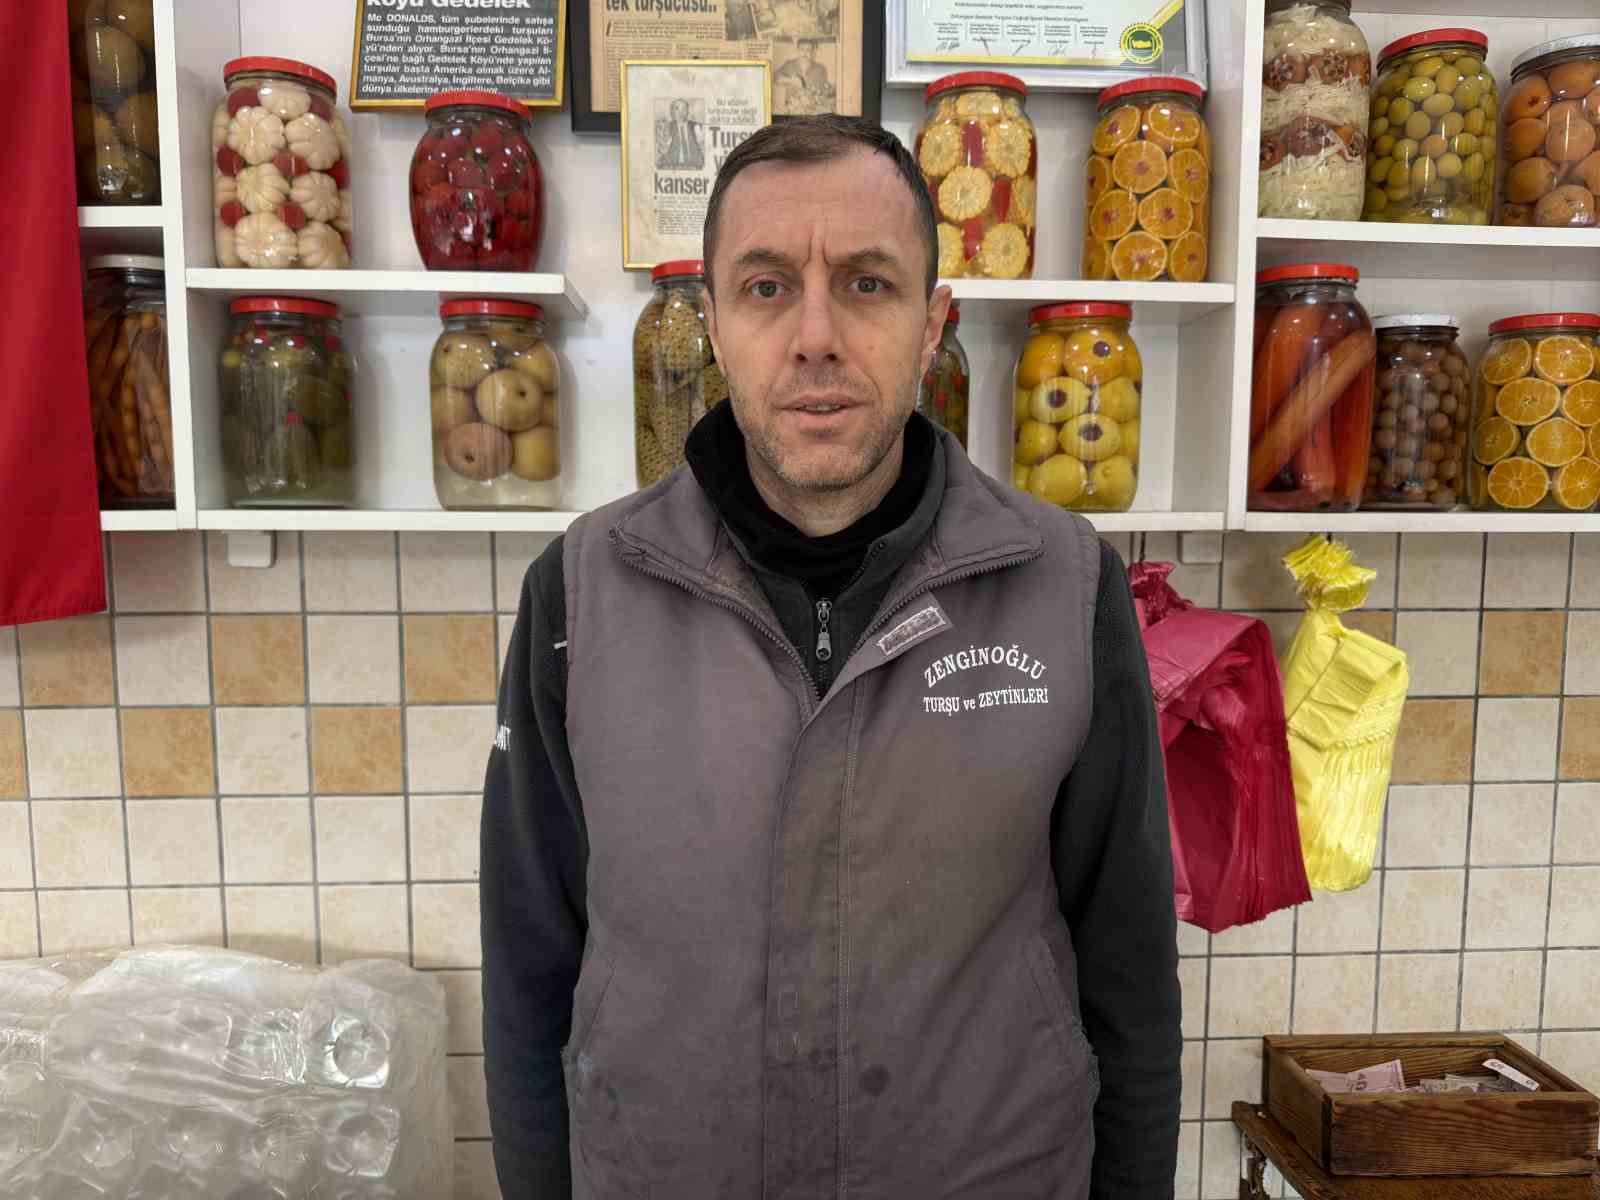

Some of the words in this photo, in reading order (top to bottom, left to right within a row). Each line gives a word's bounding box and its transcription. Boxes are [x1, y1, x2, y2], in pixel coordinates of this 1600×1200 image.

[433, 65, 473, 75] Amerika
[361, 84, 392, 95] dünya
[654, 172, 710, 195] kanser
[924, 644, 1047, 688] ZENGİNOĞLU
[923, 697, 960, 717] TURŞU
[963, 699, 976, 710] ve
[978, 684, 1049, 709] ZEYTİNLERİ
